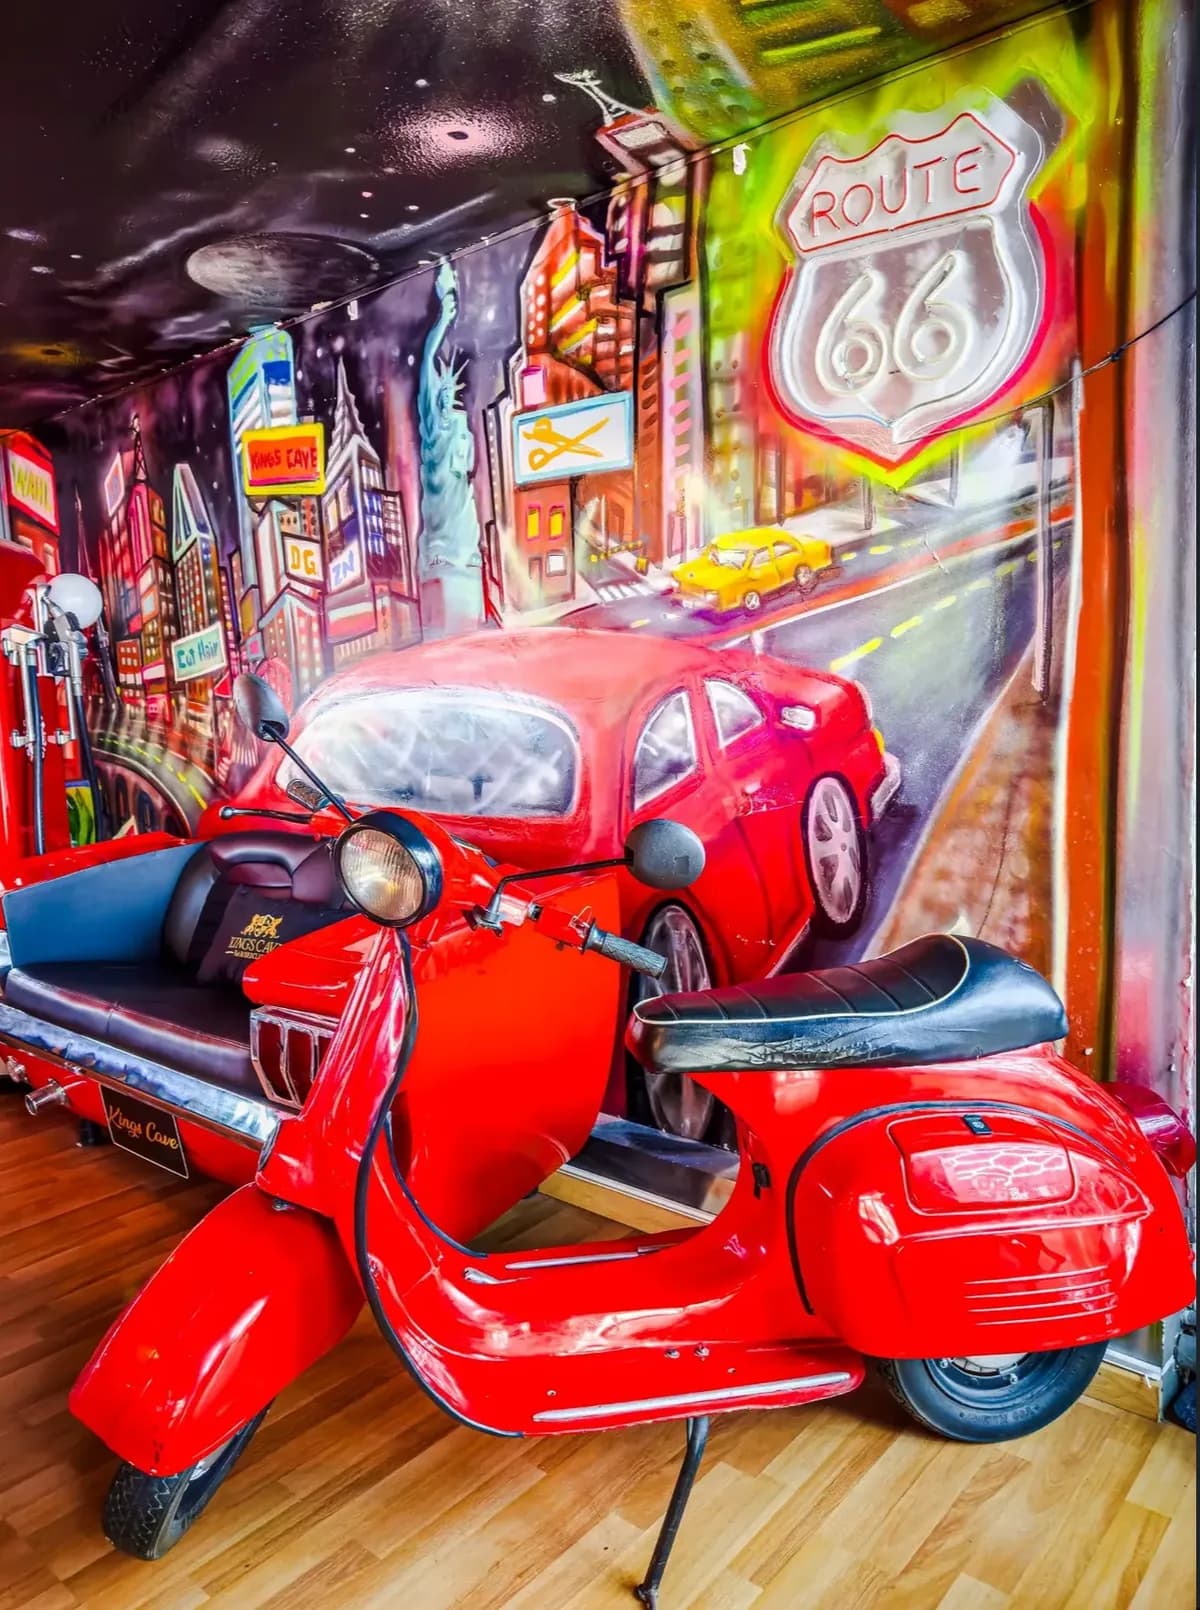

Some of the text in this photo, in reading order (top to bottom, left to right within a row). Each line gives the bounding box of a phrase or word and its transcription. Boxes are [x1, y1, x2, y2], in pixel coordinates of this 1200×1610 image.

[810, 146, 983, 238] ROUTE
[815, 251, 973, 396] 66
[287, 447, 318, 470] CAVE
[290, 545, 316, 575] DG
[332, 550, 355, 586] ZN
[109, 1105, 179, 1150] Kings Cave
